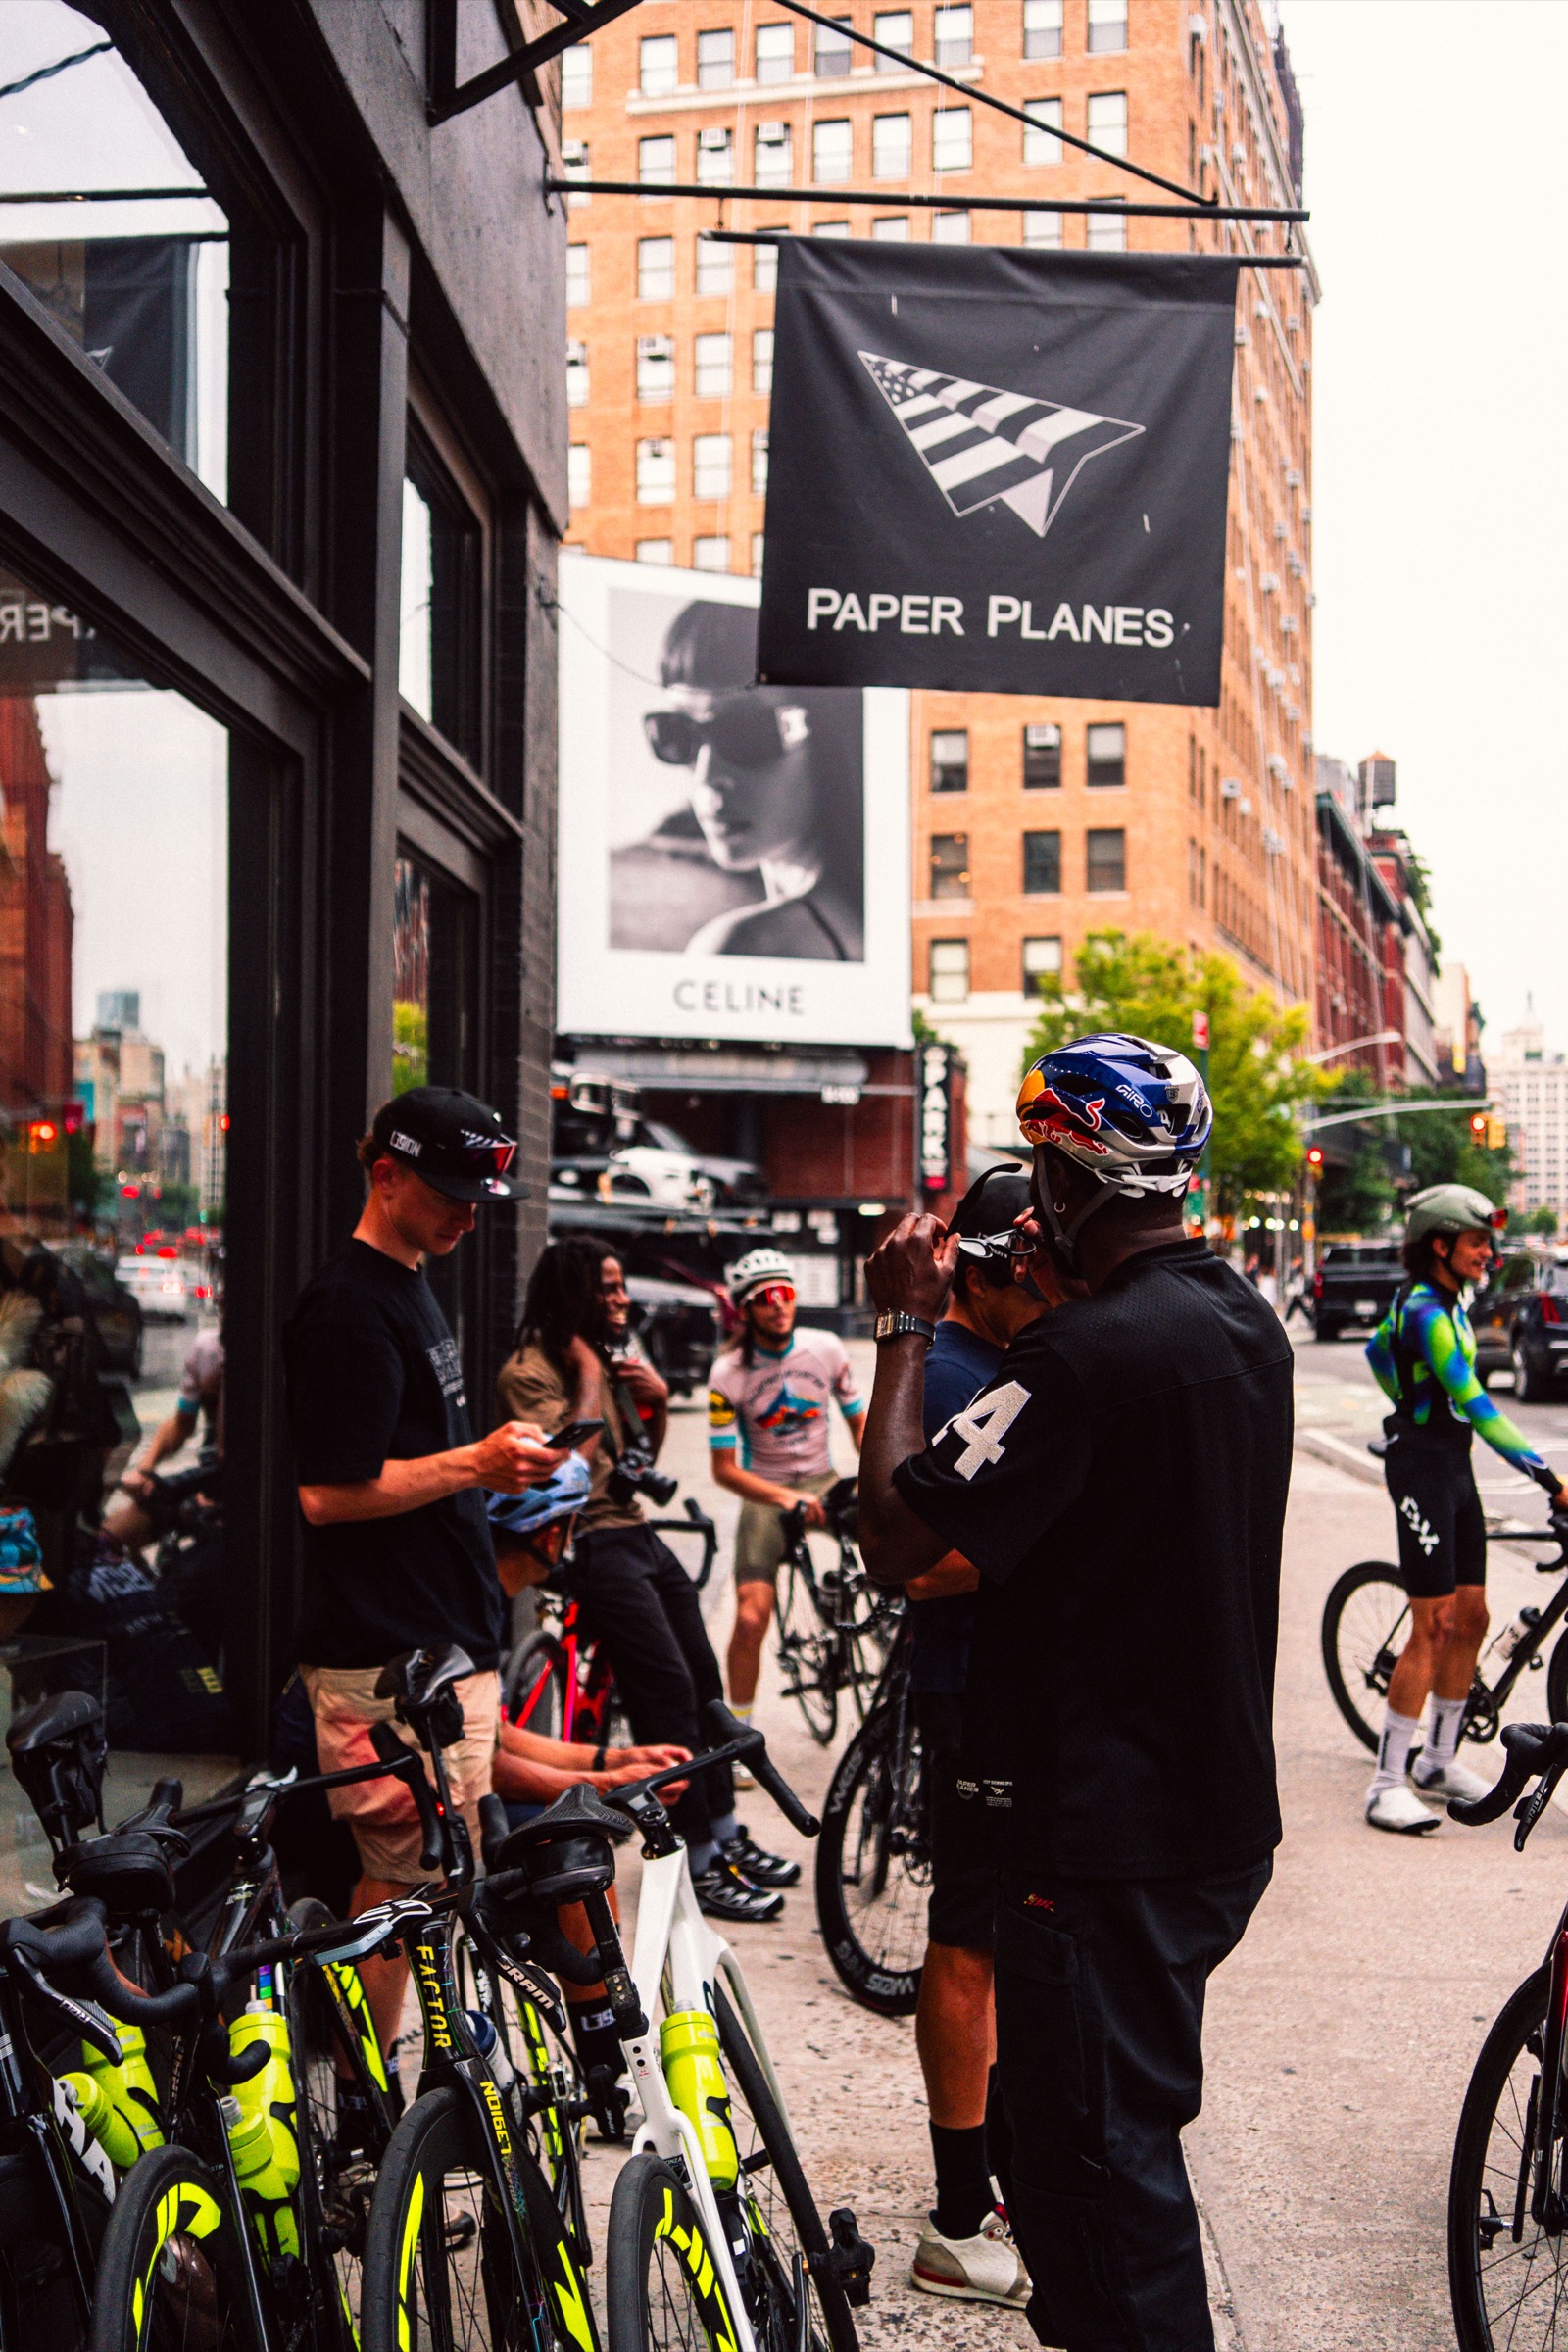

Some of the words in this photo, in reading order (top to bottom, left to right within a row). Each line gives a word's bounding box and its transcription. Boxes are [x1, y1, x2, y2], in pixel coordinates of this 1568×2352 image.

[807, 588, 965, 636] PAPER
[987, 595, 1175, 649] PLANES
[673, 978, 805, 1015] CELINE
[1116, 1084, 1152, 1118] GIRO
[953, 1380, 1032, 1481] 4
[416, 1945, 452, 2048] FACTOR
[495, 1956, 555, 2010] SRAM
